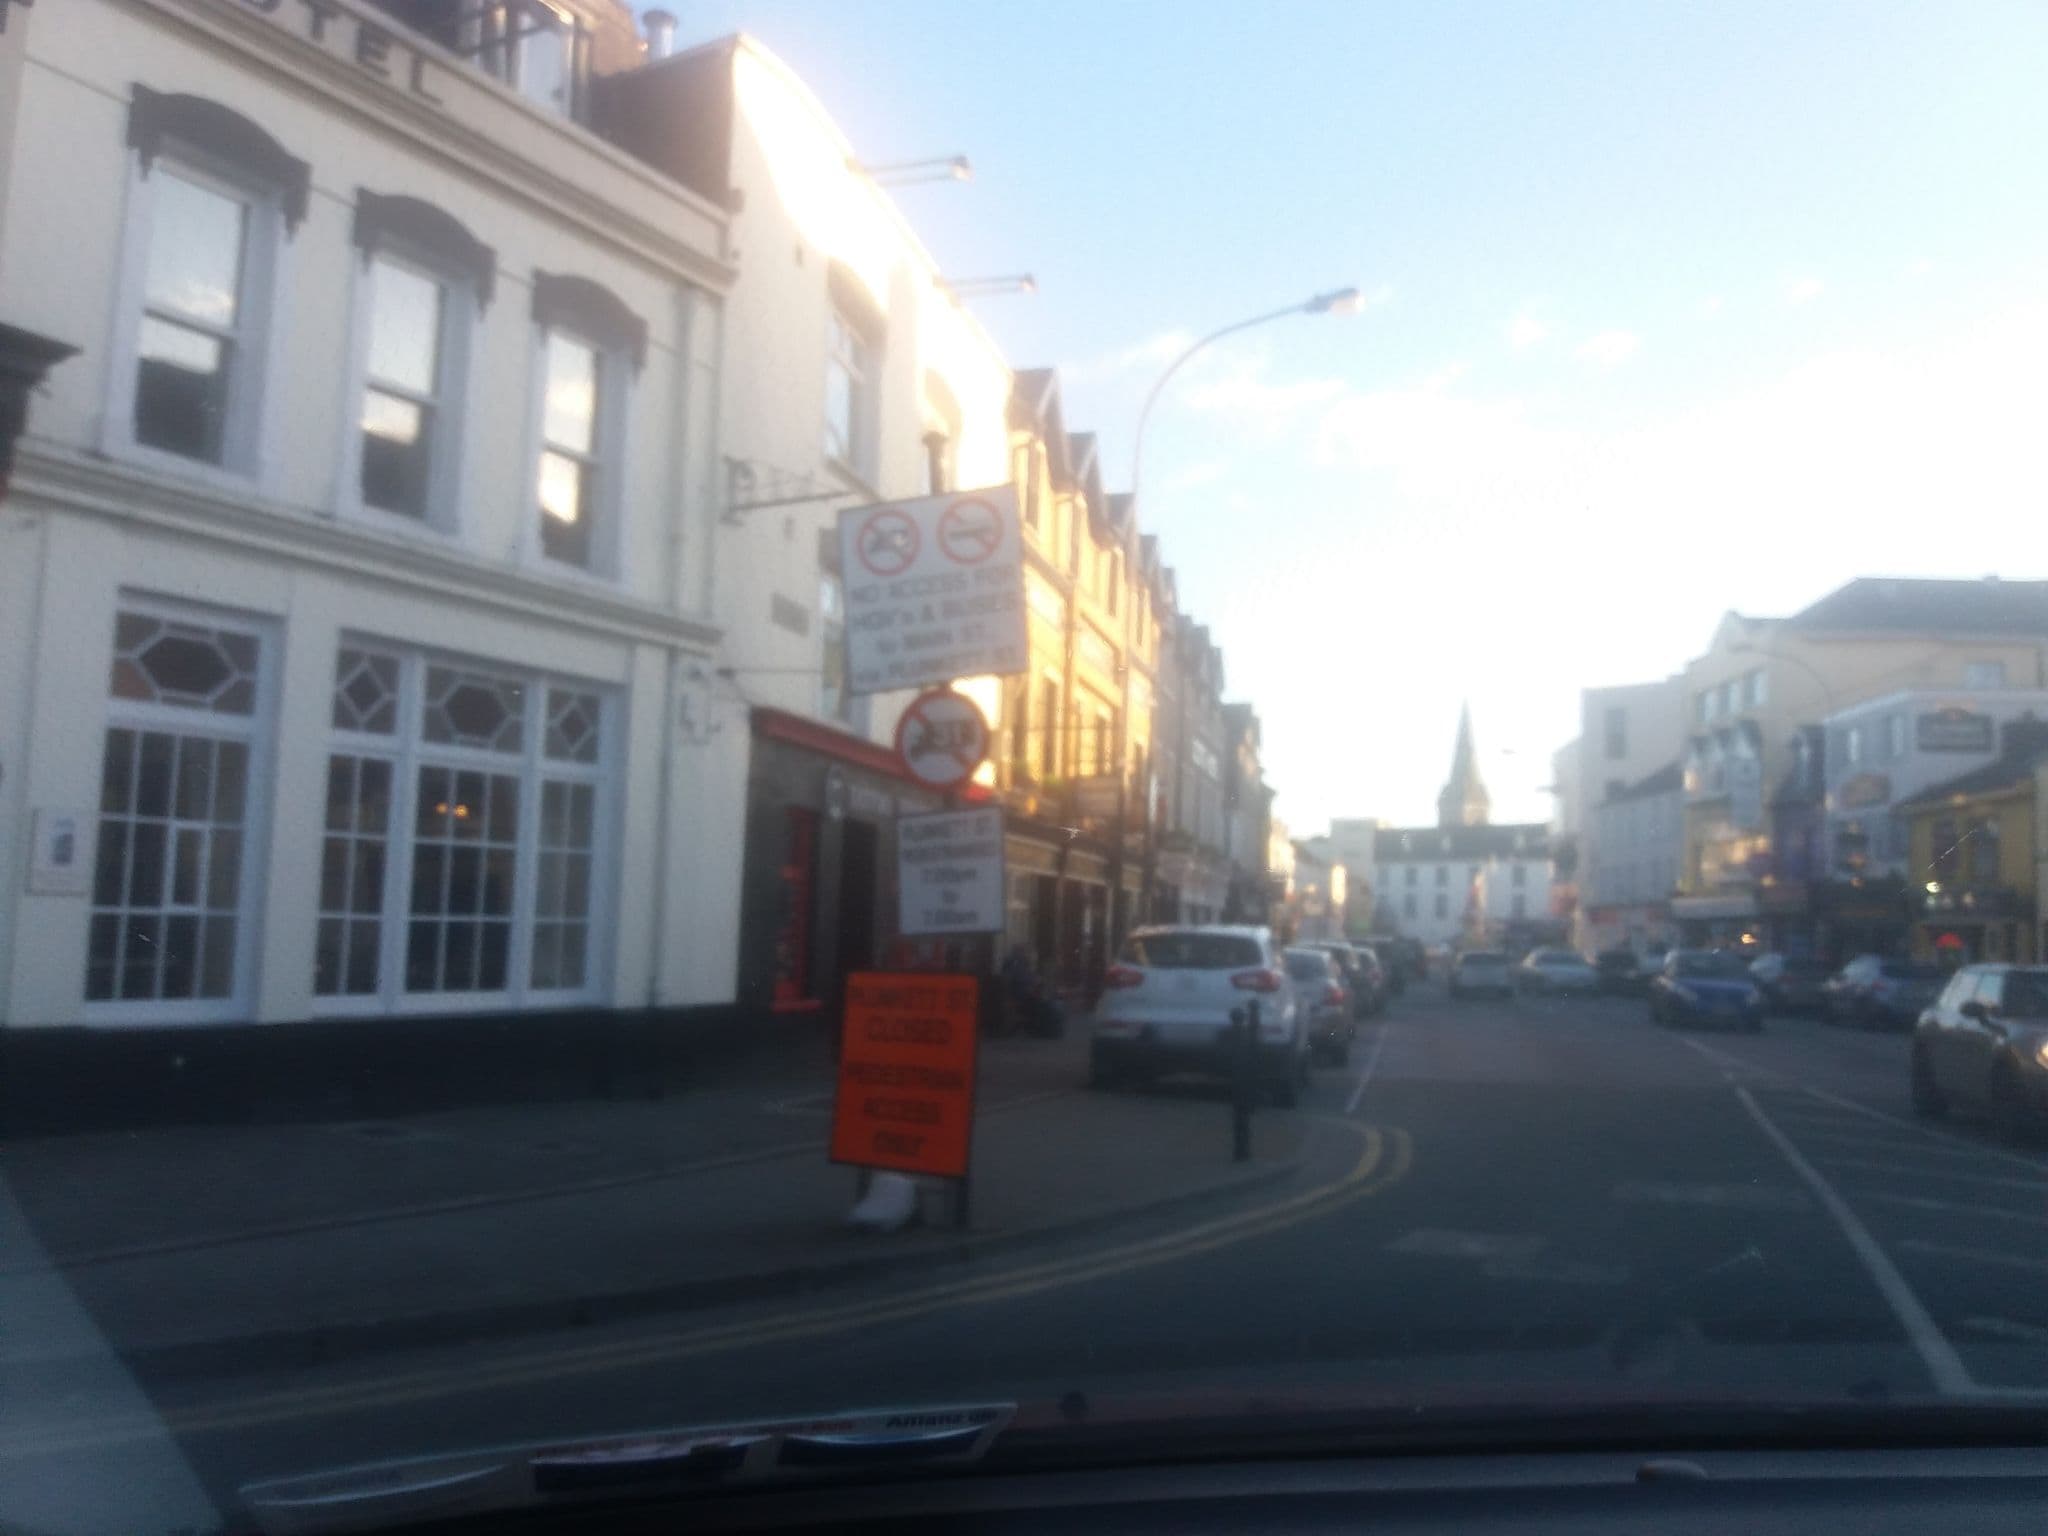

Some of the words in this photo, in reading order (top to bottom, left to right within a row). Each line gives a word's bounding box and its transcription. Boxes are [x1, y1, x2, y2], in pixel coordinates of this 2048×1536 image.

[851, 583, 880, 603] NO
[889, 571, 968, 599] ACCESS
[886, 1414, 963, 1428] Allianz
